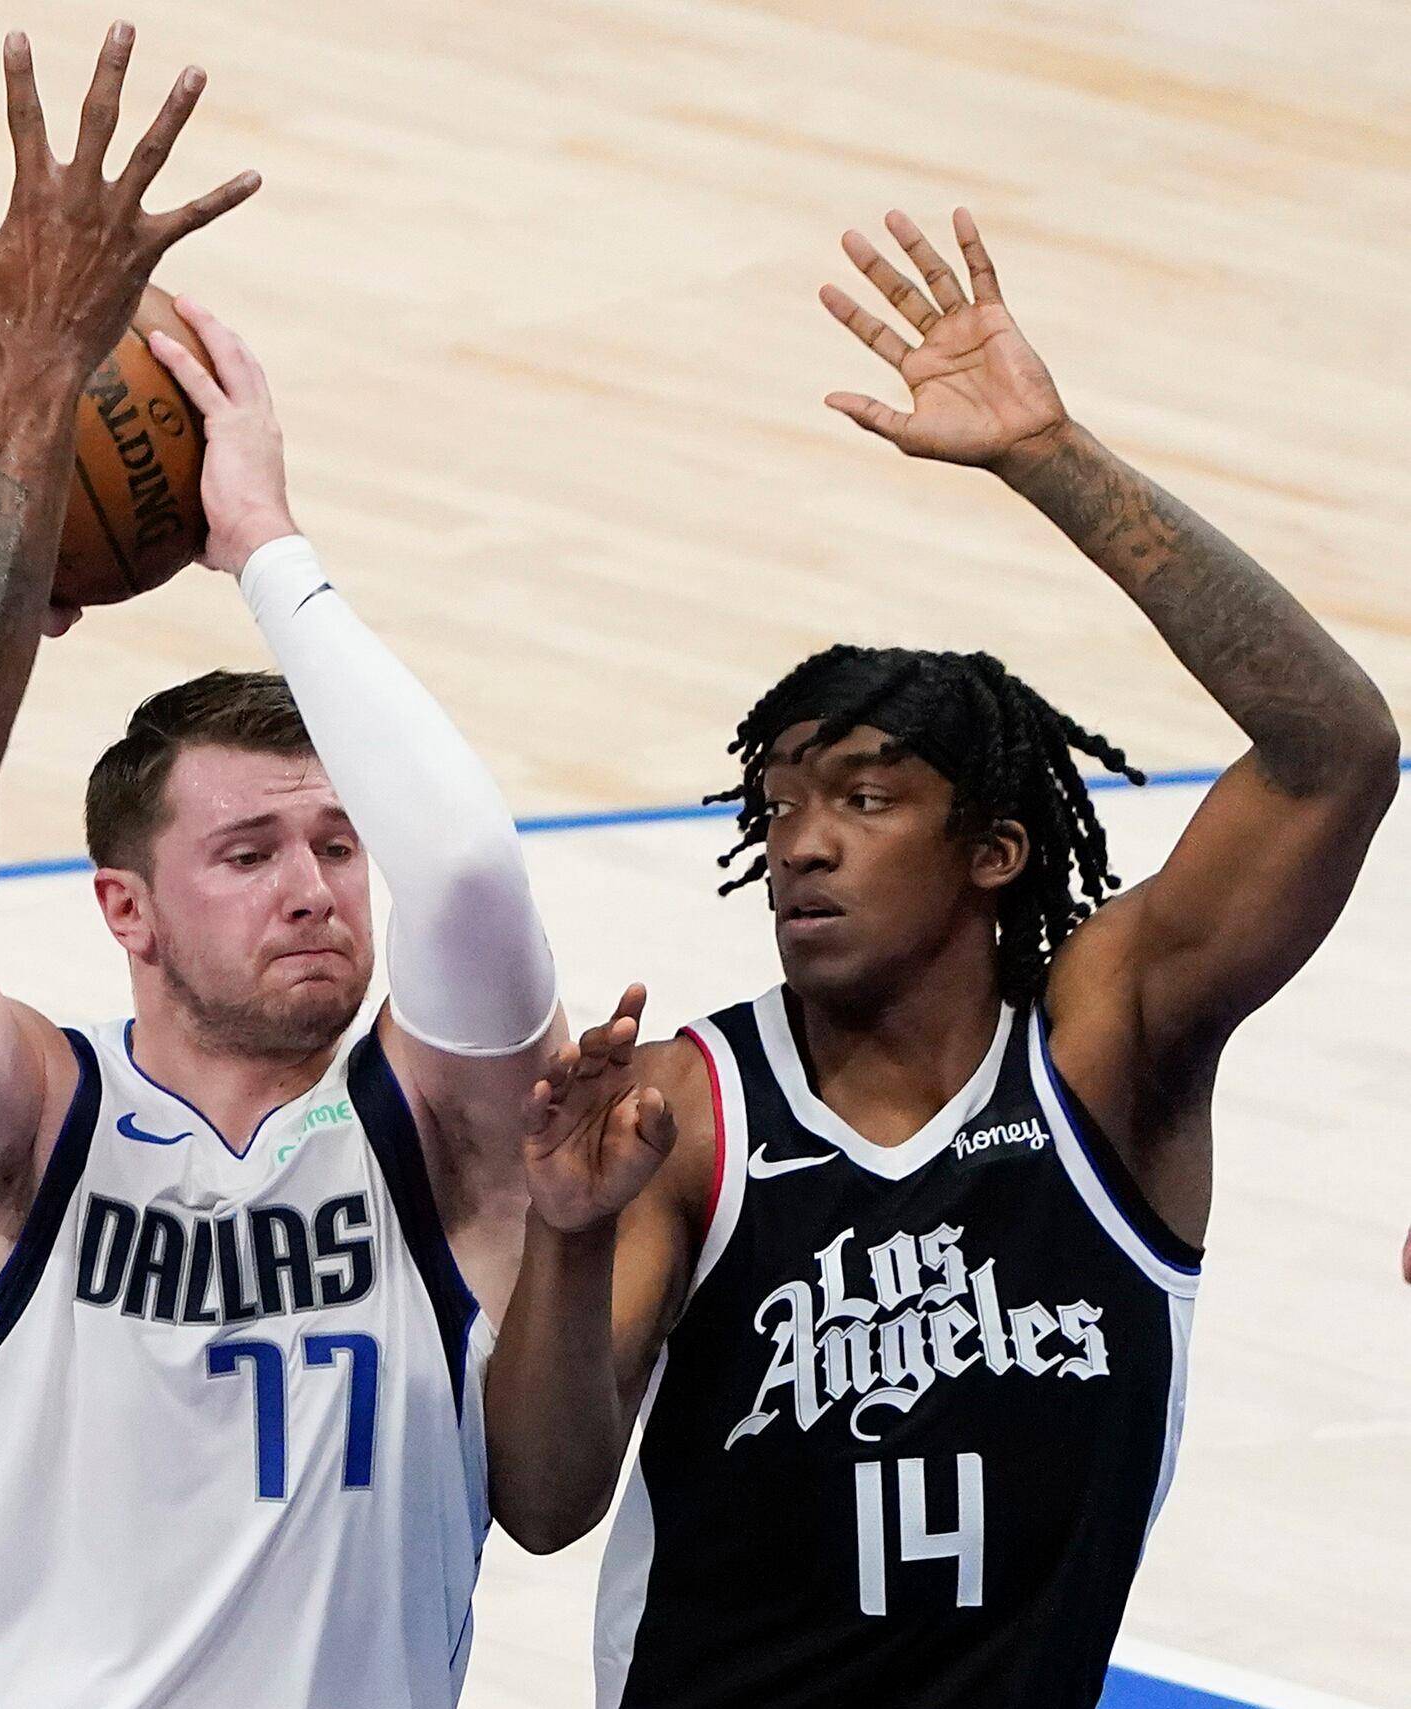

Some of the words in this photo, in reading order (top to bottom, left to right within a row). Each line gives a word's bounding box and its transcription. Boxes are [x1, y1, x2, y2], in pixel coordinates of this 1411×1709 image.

[86, 356, 185, 549] ALDING
[950, 1117, 1050, 1160] honey
[74, 1192, 377, 1327] DALLAS
[814, 1223, 969, 1331] Los
[206, 1332, 380, 1503] 77
[724, 1257, 1111, 1451] Angeles
[854, 1452, 983, 1616] 14
